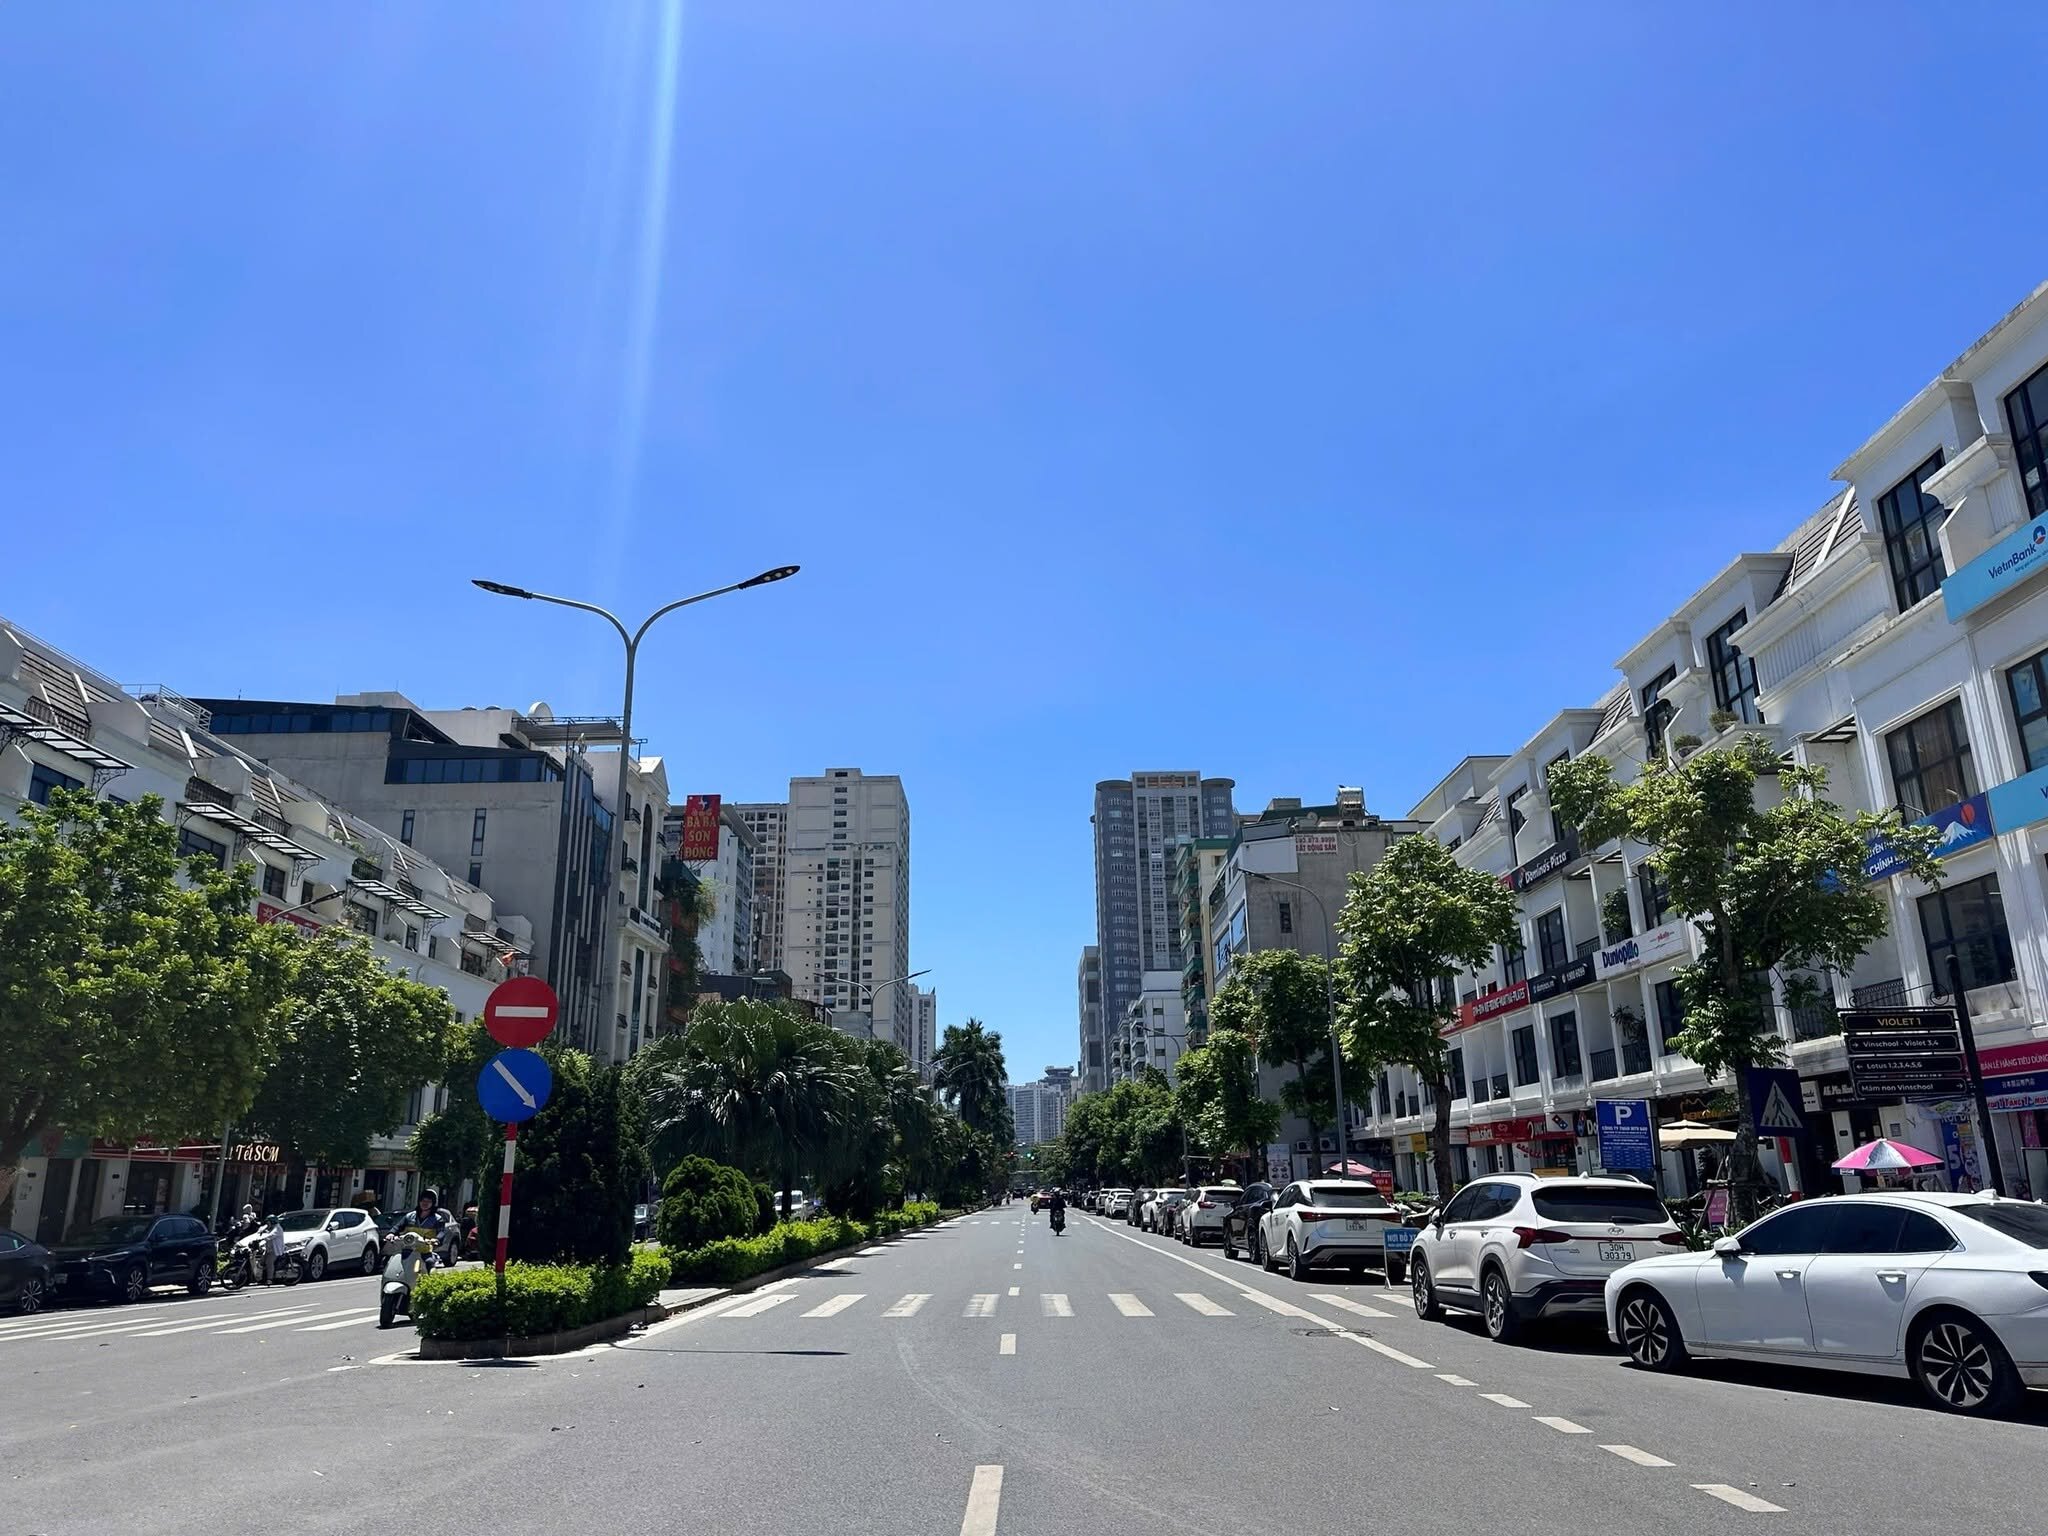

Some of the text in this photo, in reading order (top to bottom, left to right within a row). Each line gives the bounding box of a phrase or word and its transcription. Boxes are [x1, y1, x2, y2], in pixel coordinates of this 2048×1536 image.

[1988, 543, 2037, 579] VietinBank
[1525, 851, 1567, 884] Domino's Pizza
[1601, 940, 1639, 968] Dunlopillo
[1877, 1017, 1921, 1026] VIOLET 1
[1897, 1083, 1934, 1091] Vinschool
[1615, 1106, 1632, 1125] P
[1610, 1243, 1625, 1252] 30H
